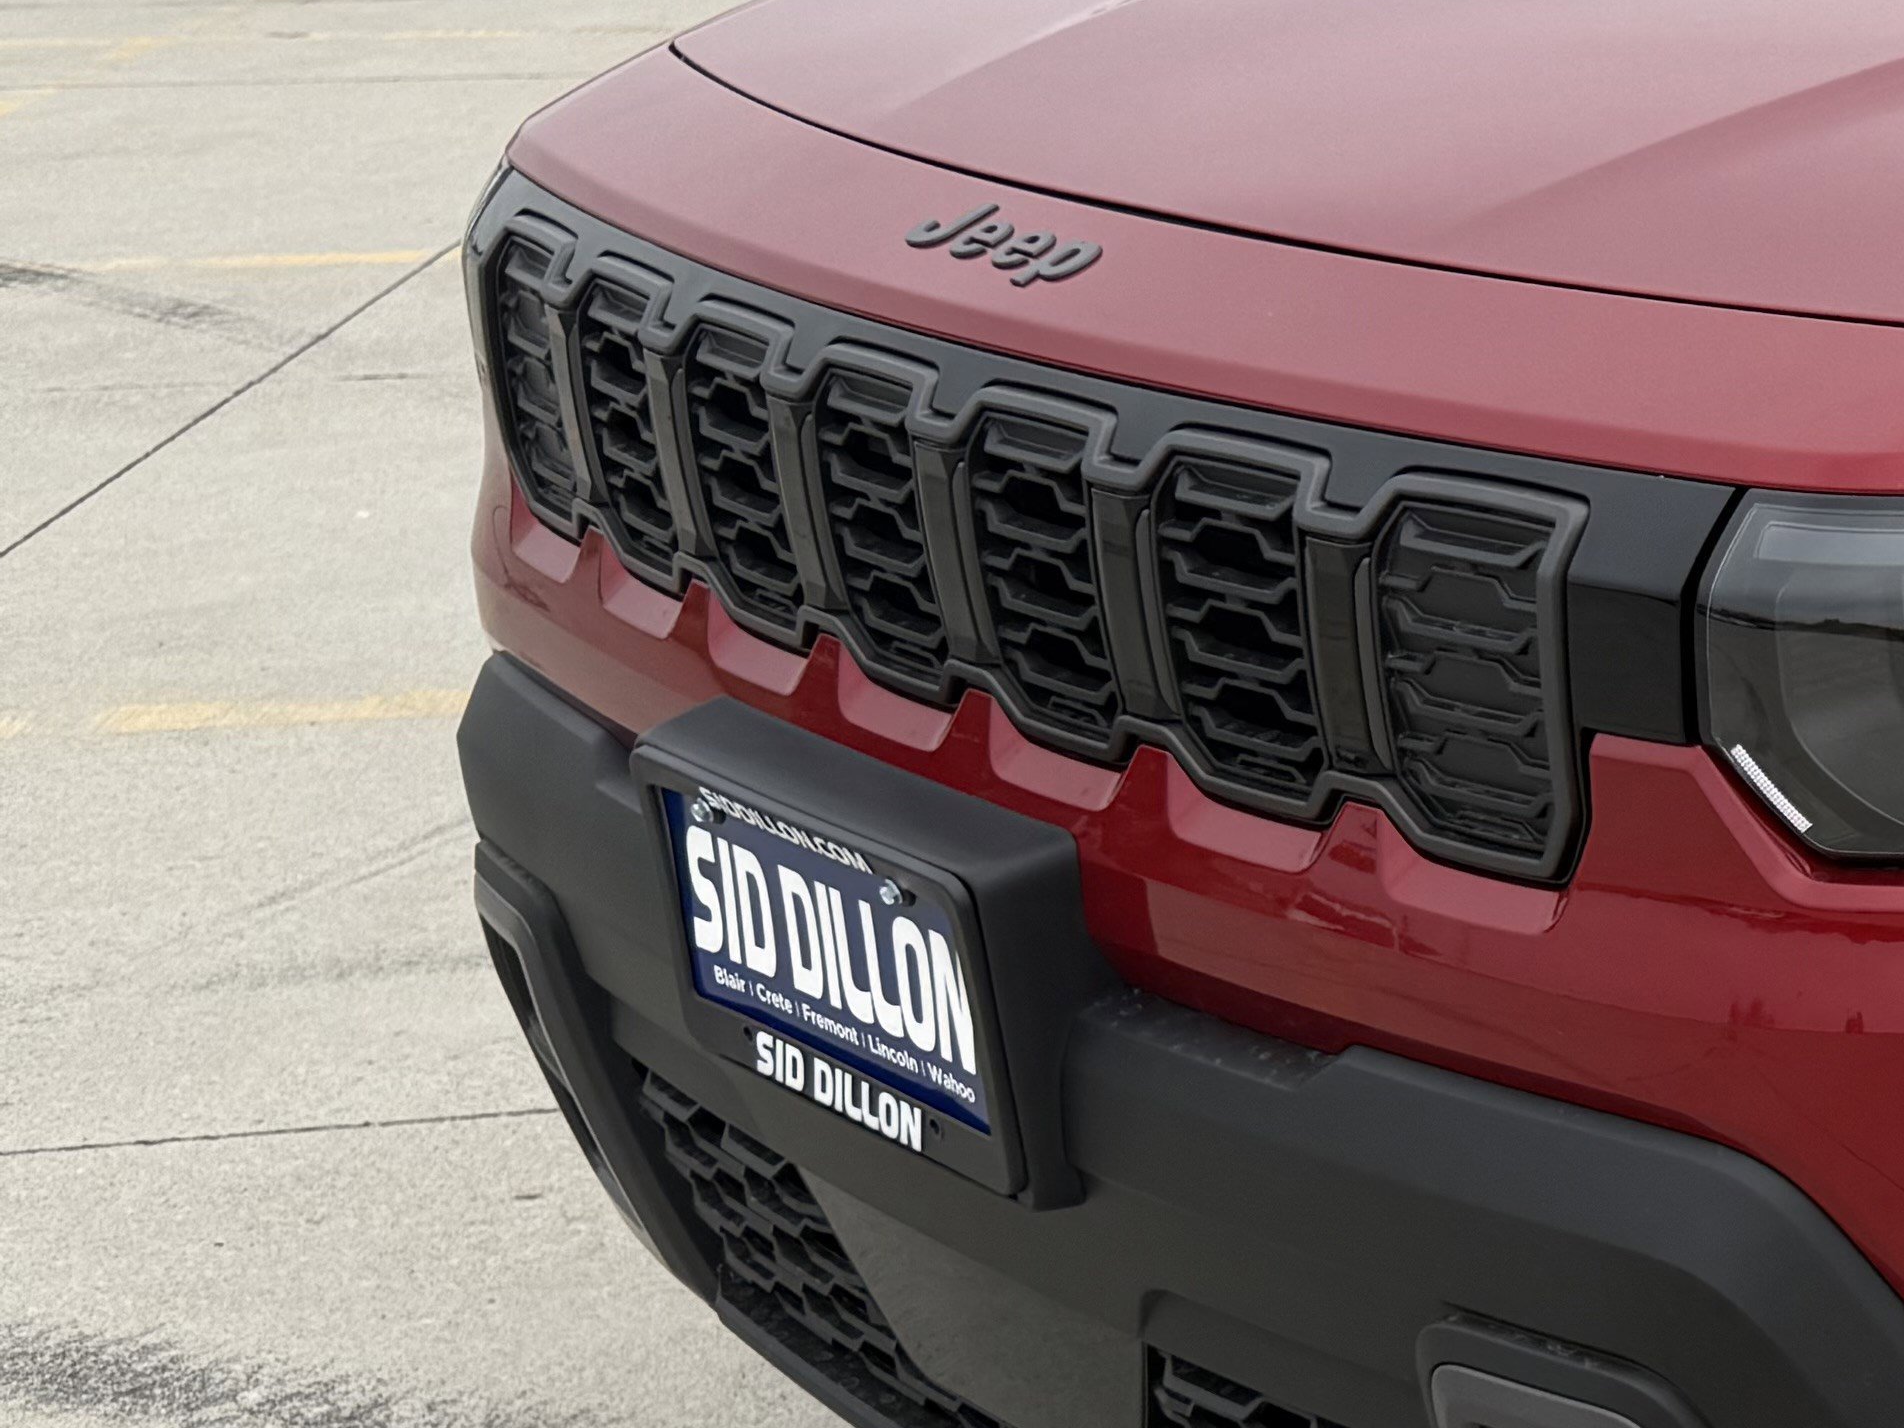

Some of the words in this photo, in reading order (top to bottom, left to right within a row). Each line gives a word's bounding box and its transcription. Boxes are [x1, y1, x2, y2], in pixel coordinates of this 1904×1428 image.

[905, 202, 1103, 289] Jeep
[698, 785, 873, 875] SIDDILLON.COM
[685, 824, 778, 980] SID
[776, 863, 978, 1076] DILLON
[713, 963, 748, 994] Blair
[755, 982, 795, 1016] Crete
[801, 1002, 860, 1048] Fremont
[868, 1033, 920, 1075] Lincoln
[926, 1060, 977, 1105] Wahoo
[755, 1030, 806, 1093] SID
[812, 1056, 924, 1154] DILLON
